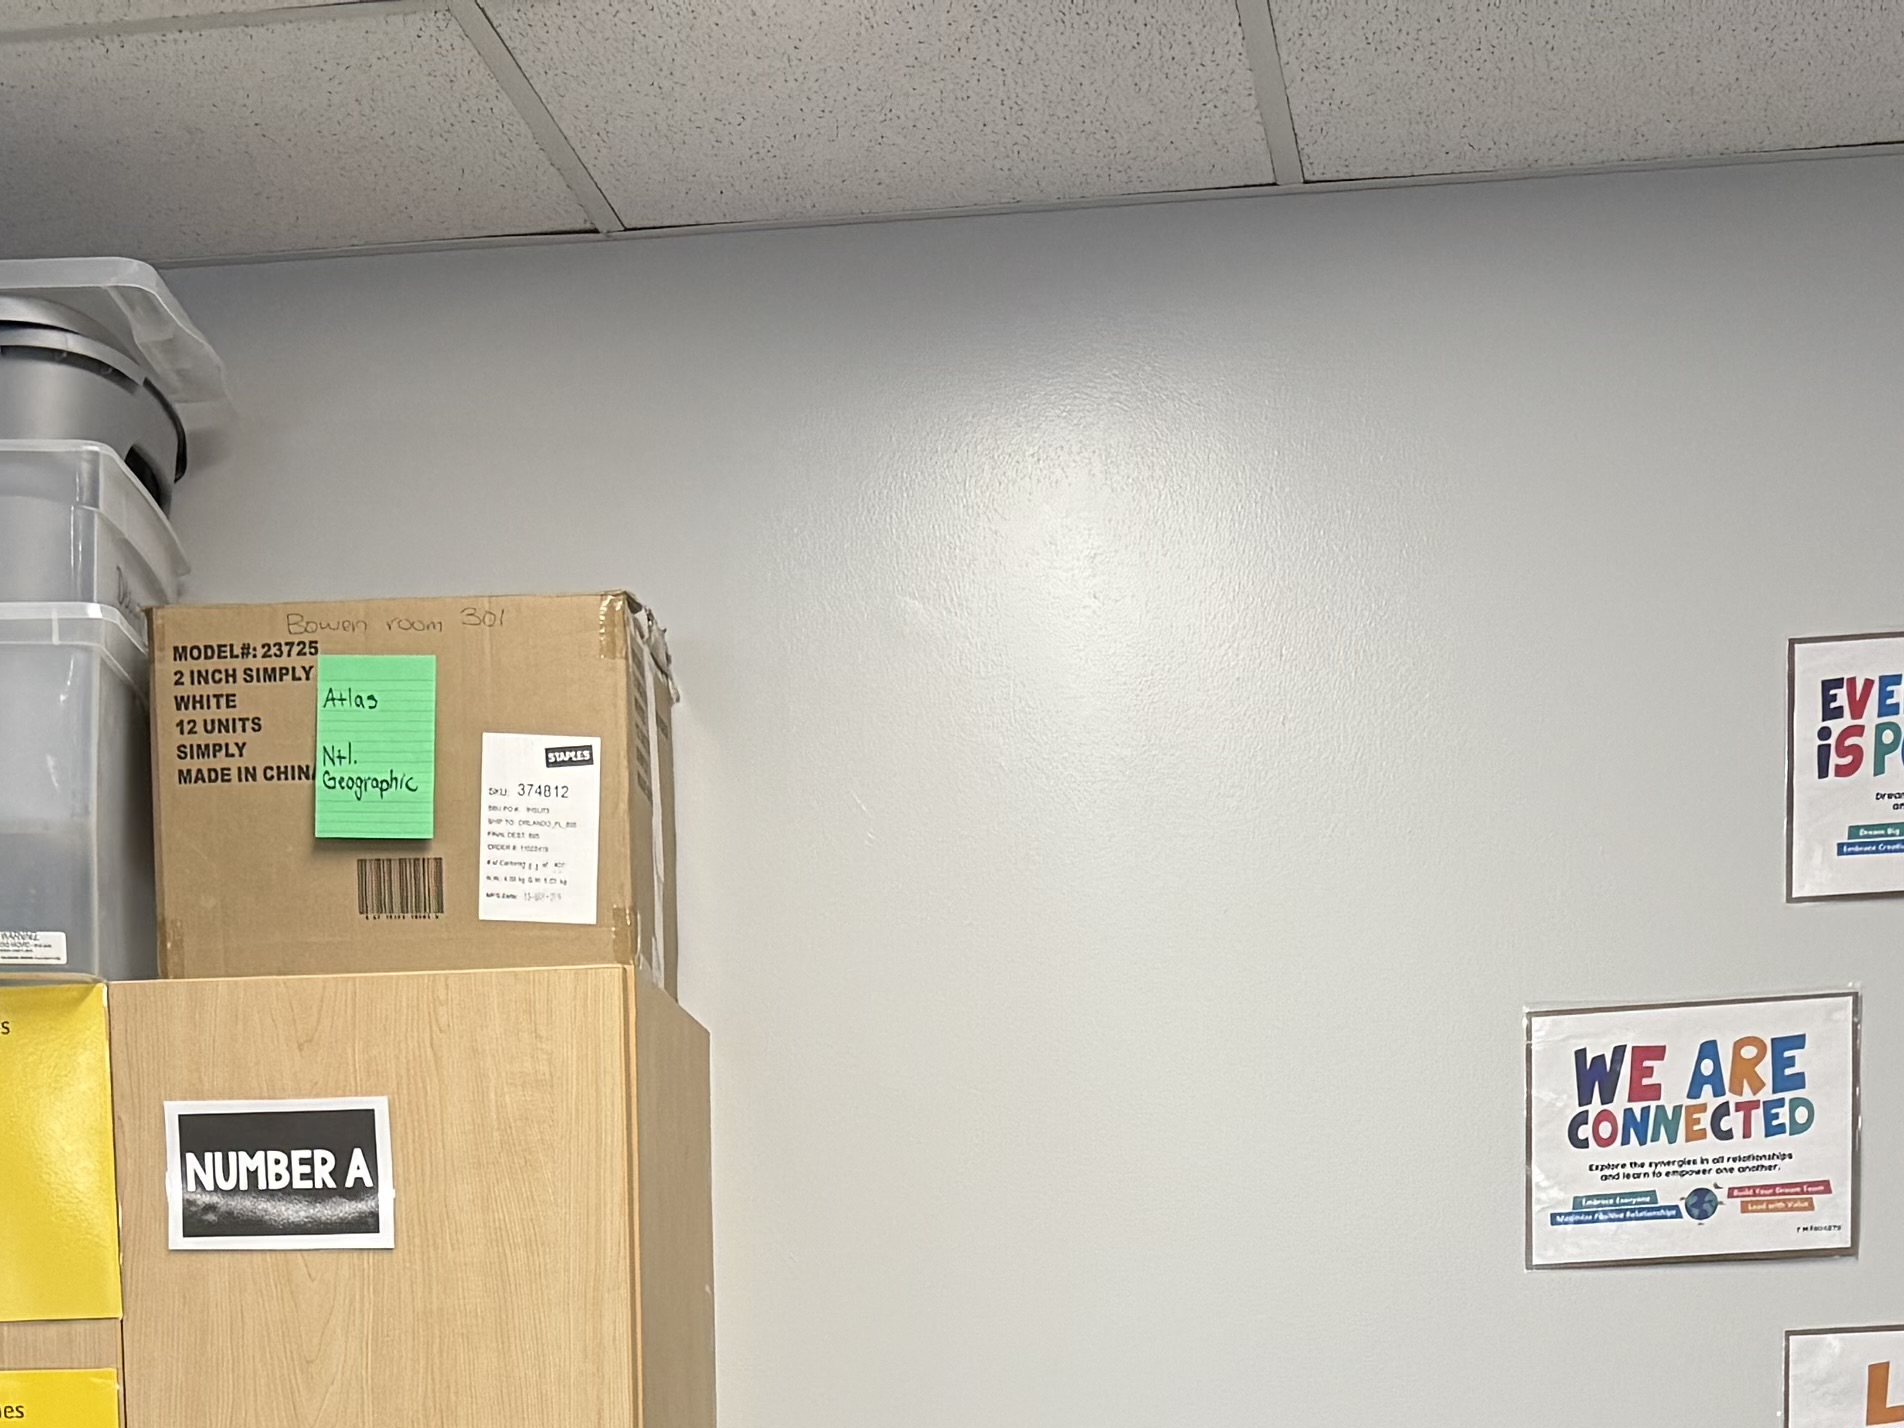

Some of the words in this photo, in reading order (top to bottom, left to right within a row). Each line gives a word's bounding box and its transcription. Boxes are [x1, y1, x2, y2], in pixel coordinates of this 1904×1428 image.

[386, 616, 443, 633] room
[173, 644, 258, 662] MODEL#:
[261, 639, 320, 659] 23725
[173, 669, 185, 686] 2
[190, 667, 237, 685] INCH
[243, 664, 314, 683] SIMPLY
[174, 693, 238, 711] WHITE
[322, 687, 379, 710] Atlas
[176, 719, 198, 735] 12
[203, 716, 262, 734] UNITS
[176, 741, 247, 760] SIMPLY
[547, 750, 591, 763] STAPLES
[177, 767, 233, 785] MADE
[237, 766, 258, 783] IN
[322, 769, 419, 801] Geographic
[1574, 1043, 1667, 1107] WE
[1686, 1033, 1807, 1100] ARE
[1567, 1096, 1815, 1149] CONNECTED
[184, 1149, 337, 1192] NUMBER
[344, 1146, 374, 1189] A
